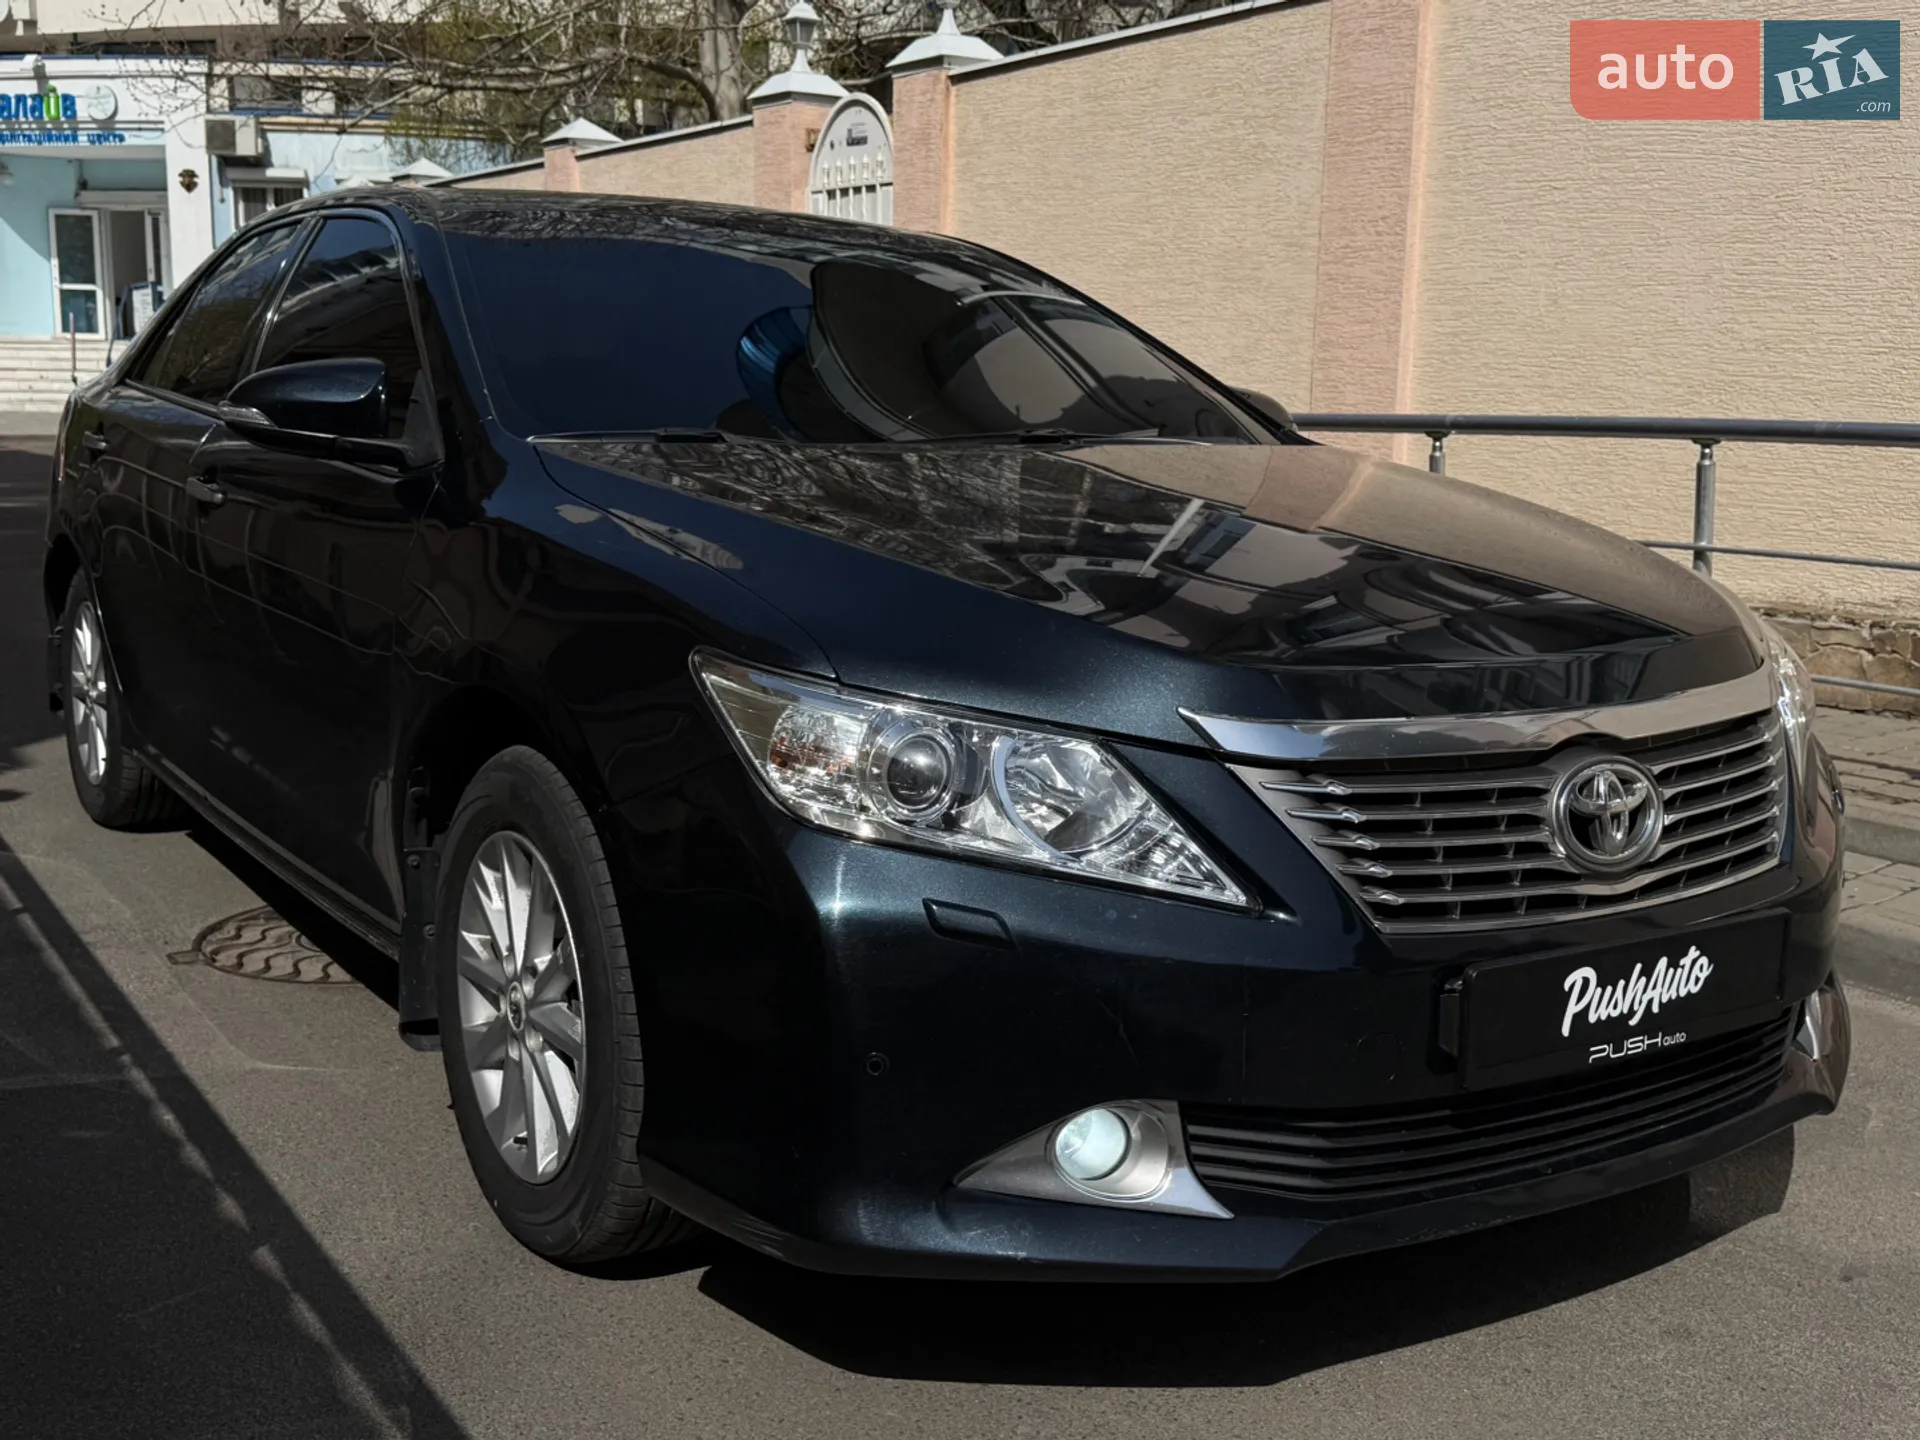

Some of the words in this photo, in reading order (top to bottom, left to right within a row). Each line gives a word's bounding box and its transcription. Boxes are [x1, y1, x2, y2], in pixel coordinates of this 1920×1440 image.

[1561, 945, 1714, 1037] PushAuto
[1588, 1031, 1662, 1064] PUSH
[1663, 1031, 1687, 1046] auto
